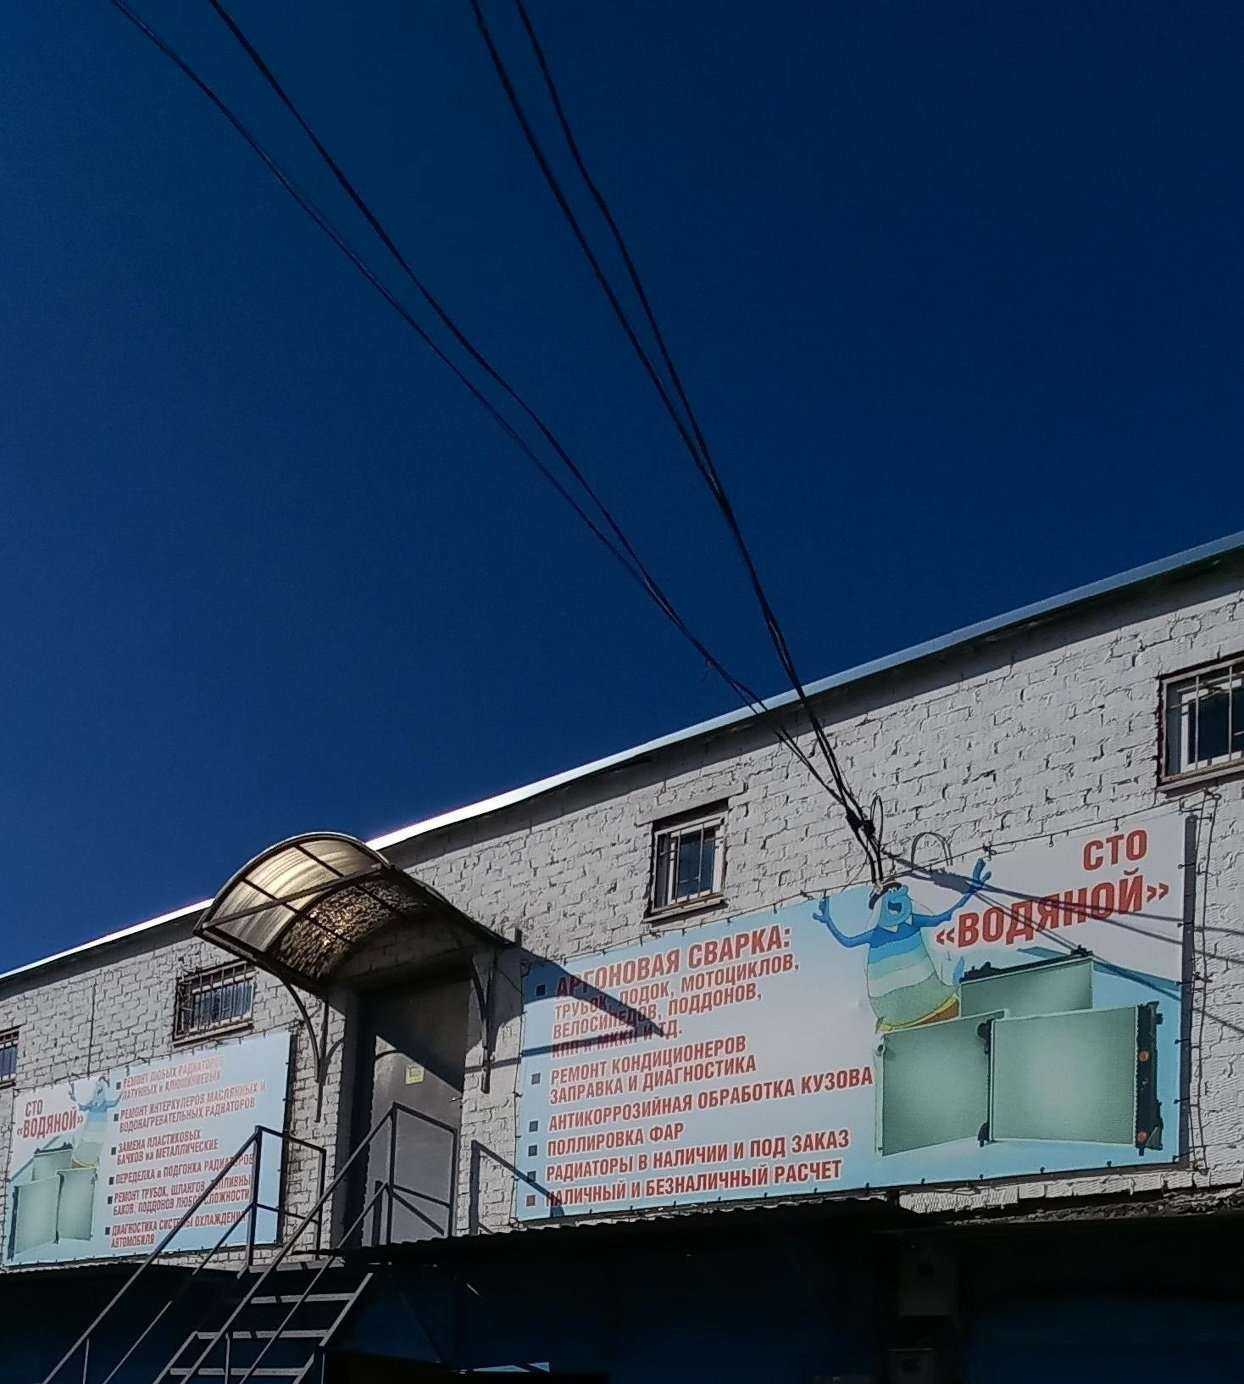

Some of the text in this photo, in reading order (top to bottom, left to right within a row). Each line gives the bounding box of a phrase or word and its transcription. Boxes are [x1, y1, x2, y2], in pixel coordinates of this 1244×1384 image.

[1083, 829, 1147, 871] СТО
[936, 867, 1169, 948] «ВОДЯНОЙ»
[557, 925, 790, 997] АРГОНОВАЯ СВАРКА:
[620, 979, 674, 1006] ЛОДОК,
[681, 954, 799, 993] МОТОЦИКЛОВ,
[552, 983, 762, 1039] ВЕЛОСИПЕДОВ, ПОДДОНОВ,
[551, 1035, 746, 1085] РЕМОНТ КОНДИЦИОНЕРОВ
[550, 1055, 757, 1105] ЗАПРАВКА И ДИАГНОСТИКА
[25, 1099, 43, 1117] СТО
[120, 1105, 148, 1119] РЕМОНТ
[205, 1097, 256, 1118] РАДИАТОРОВ
[549, 1066, 873, 1131] АНТИКОРРОЗИЙНАЯ ОБРАБОТКА КУЗОВА
[17, 1106, 84, 1138] «ВОДЯНОЙ»
[547, 1122, 684, 1157] ПОЛЛИРОВКА ФАР
[116, 1151, 143, 1166] БАЧКОВ
[156, 1138, 219, 1160] МЕТАЛЛИЧЕСКИЕ
[118, 1130, 200, 1153] ЗАМЕНА ПЛАСТИКОВЫХ
[546, 1129, 849, 1183] РАДИАТОРЫ В НАЛИЧИИ И ПОД ЗАКАЗ
[116, 1169, 156, 1185] ПЕРЕДЕЛКА
[163, 1162, 202, 1180] ПОДГОНКА
[546, 1160, 842, 1207] НАЛИЧНЫЙ И БЕЗНАЛИЧНЫЙ РАСЧЕТ
[114, 1189, 139, 1203] РЕМОНТ
[111, 1220, 158, 1237] ДИАГНОСТИКА
[111, 1233, 156, 1248] АВТОМОБИЛЯ
